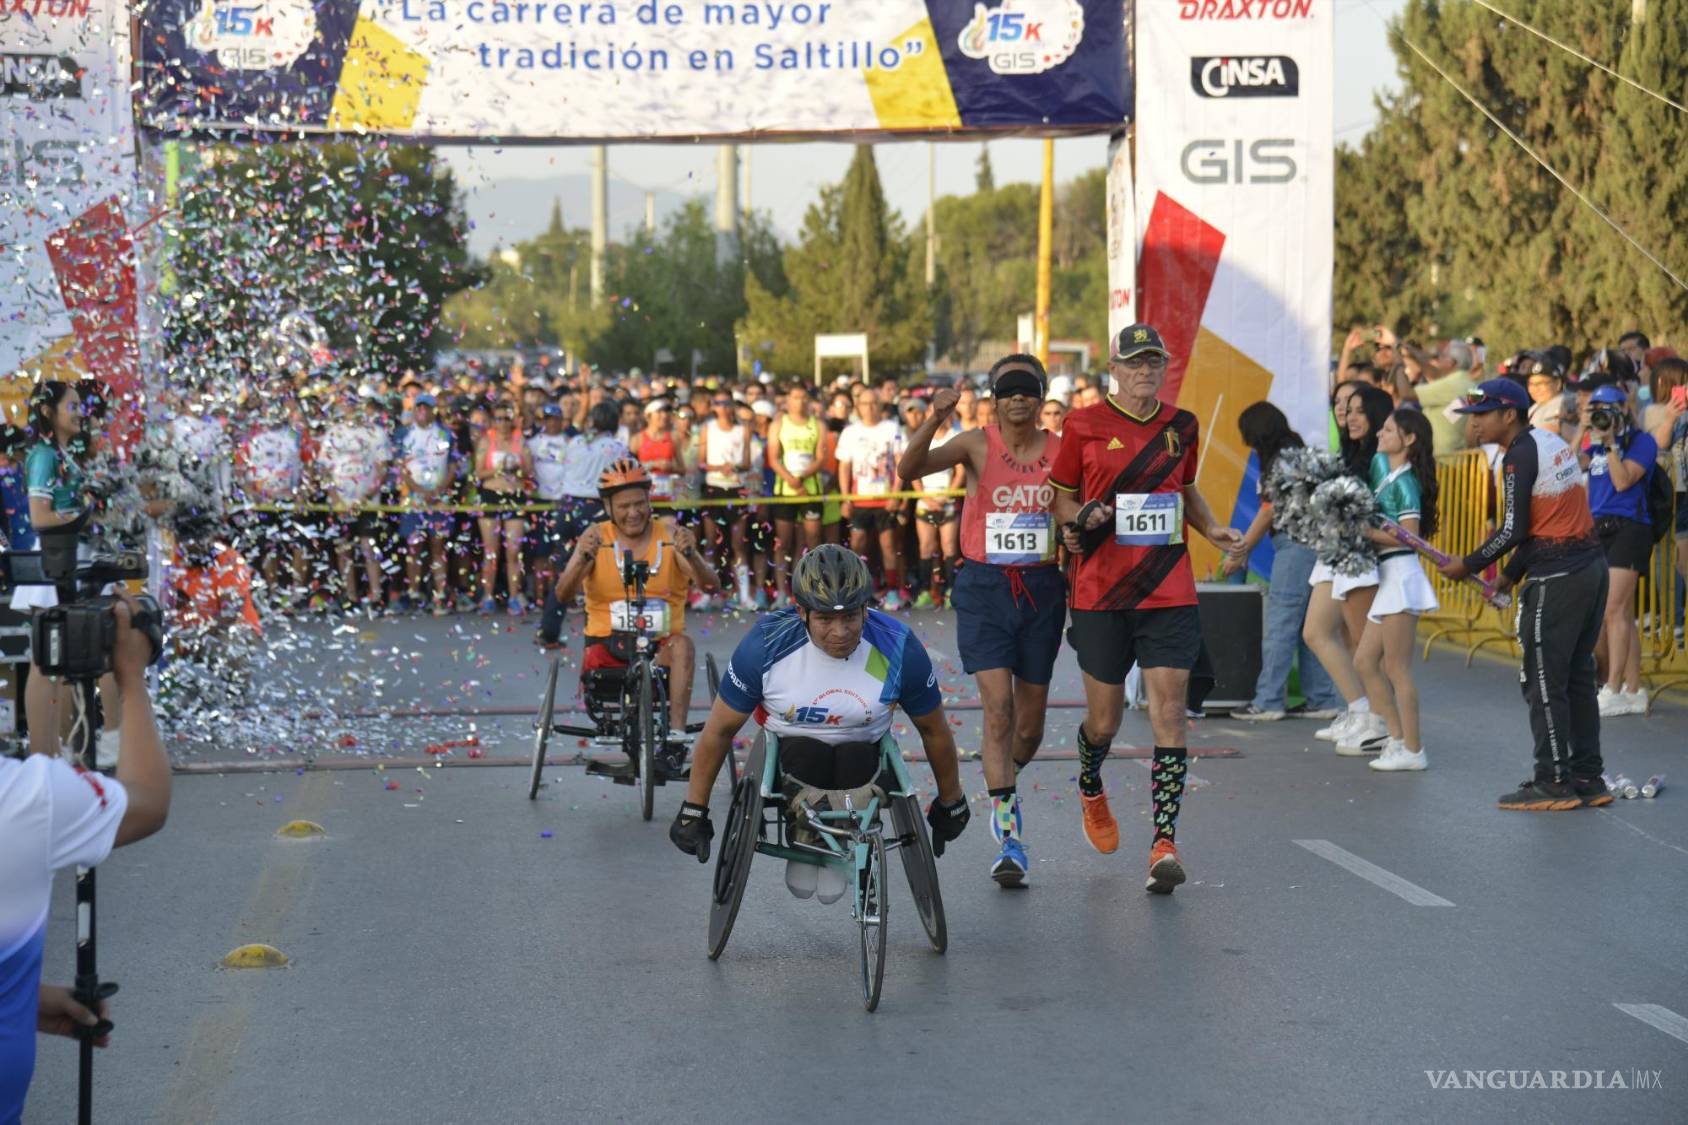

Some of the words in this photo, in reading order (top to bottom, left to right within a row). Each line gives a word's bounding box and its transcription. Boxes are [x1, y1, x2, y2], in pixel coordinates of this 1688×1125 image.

[0, 0, 88, 17] XTON
[466, 0, 616, 24] carrera
[636, 0, 684, 25] de
[703, 3, 832, 30] mayor
[1178, 0, 1312, 20] DRAXTON
[478, 41, 669, 70] tradición
[688, 49, 734, 70] en
[994, 52, 1037, 69] GIS
[0, 138, 84, 187] IS
[1180, 138, 1298, 185] GIS
[1126, 513, 1166, 532] 1611
[994, 533, 1037, 551] 1613
[796, 706, 844, 726] 15K
